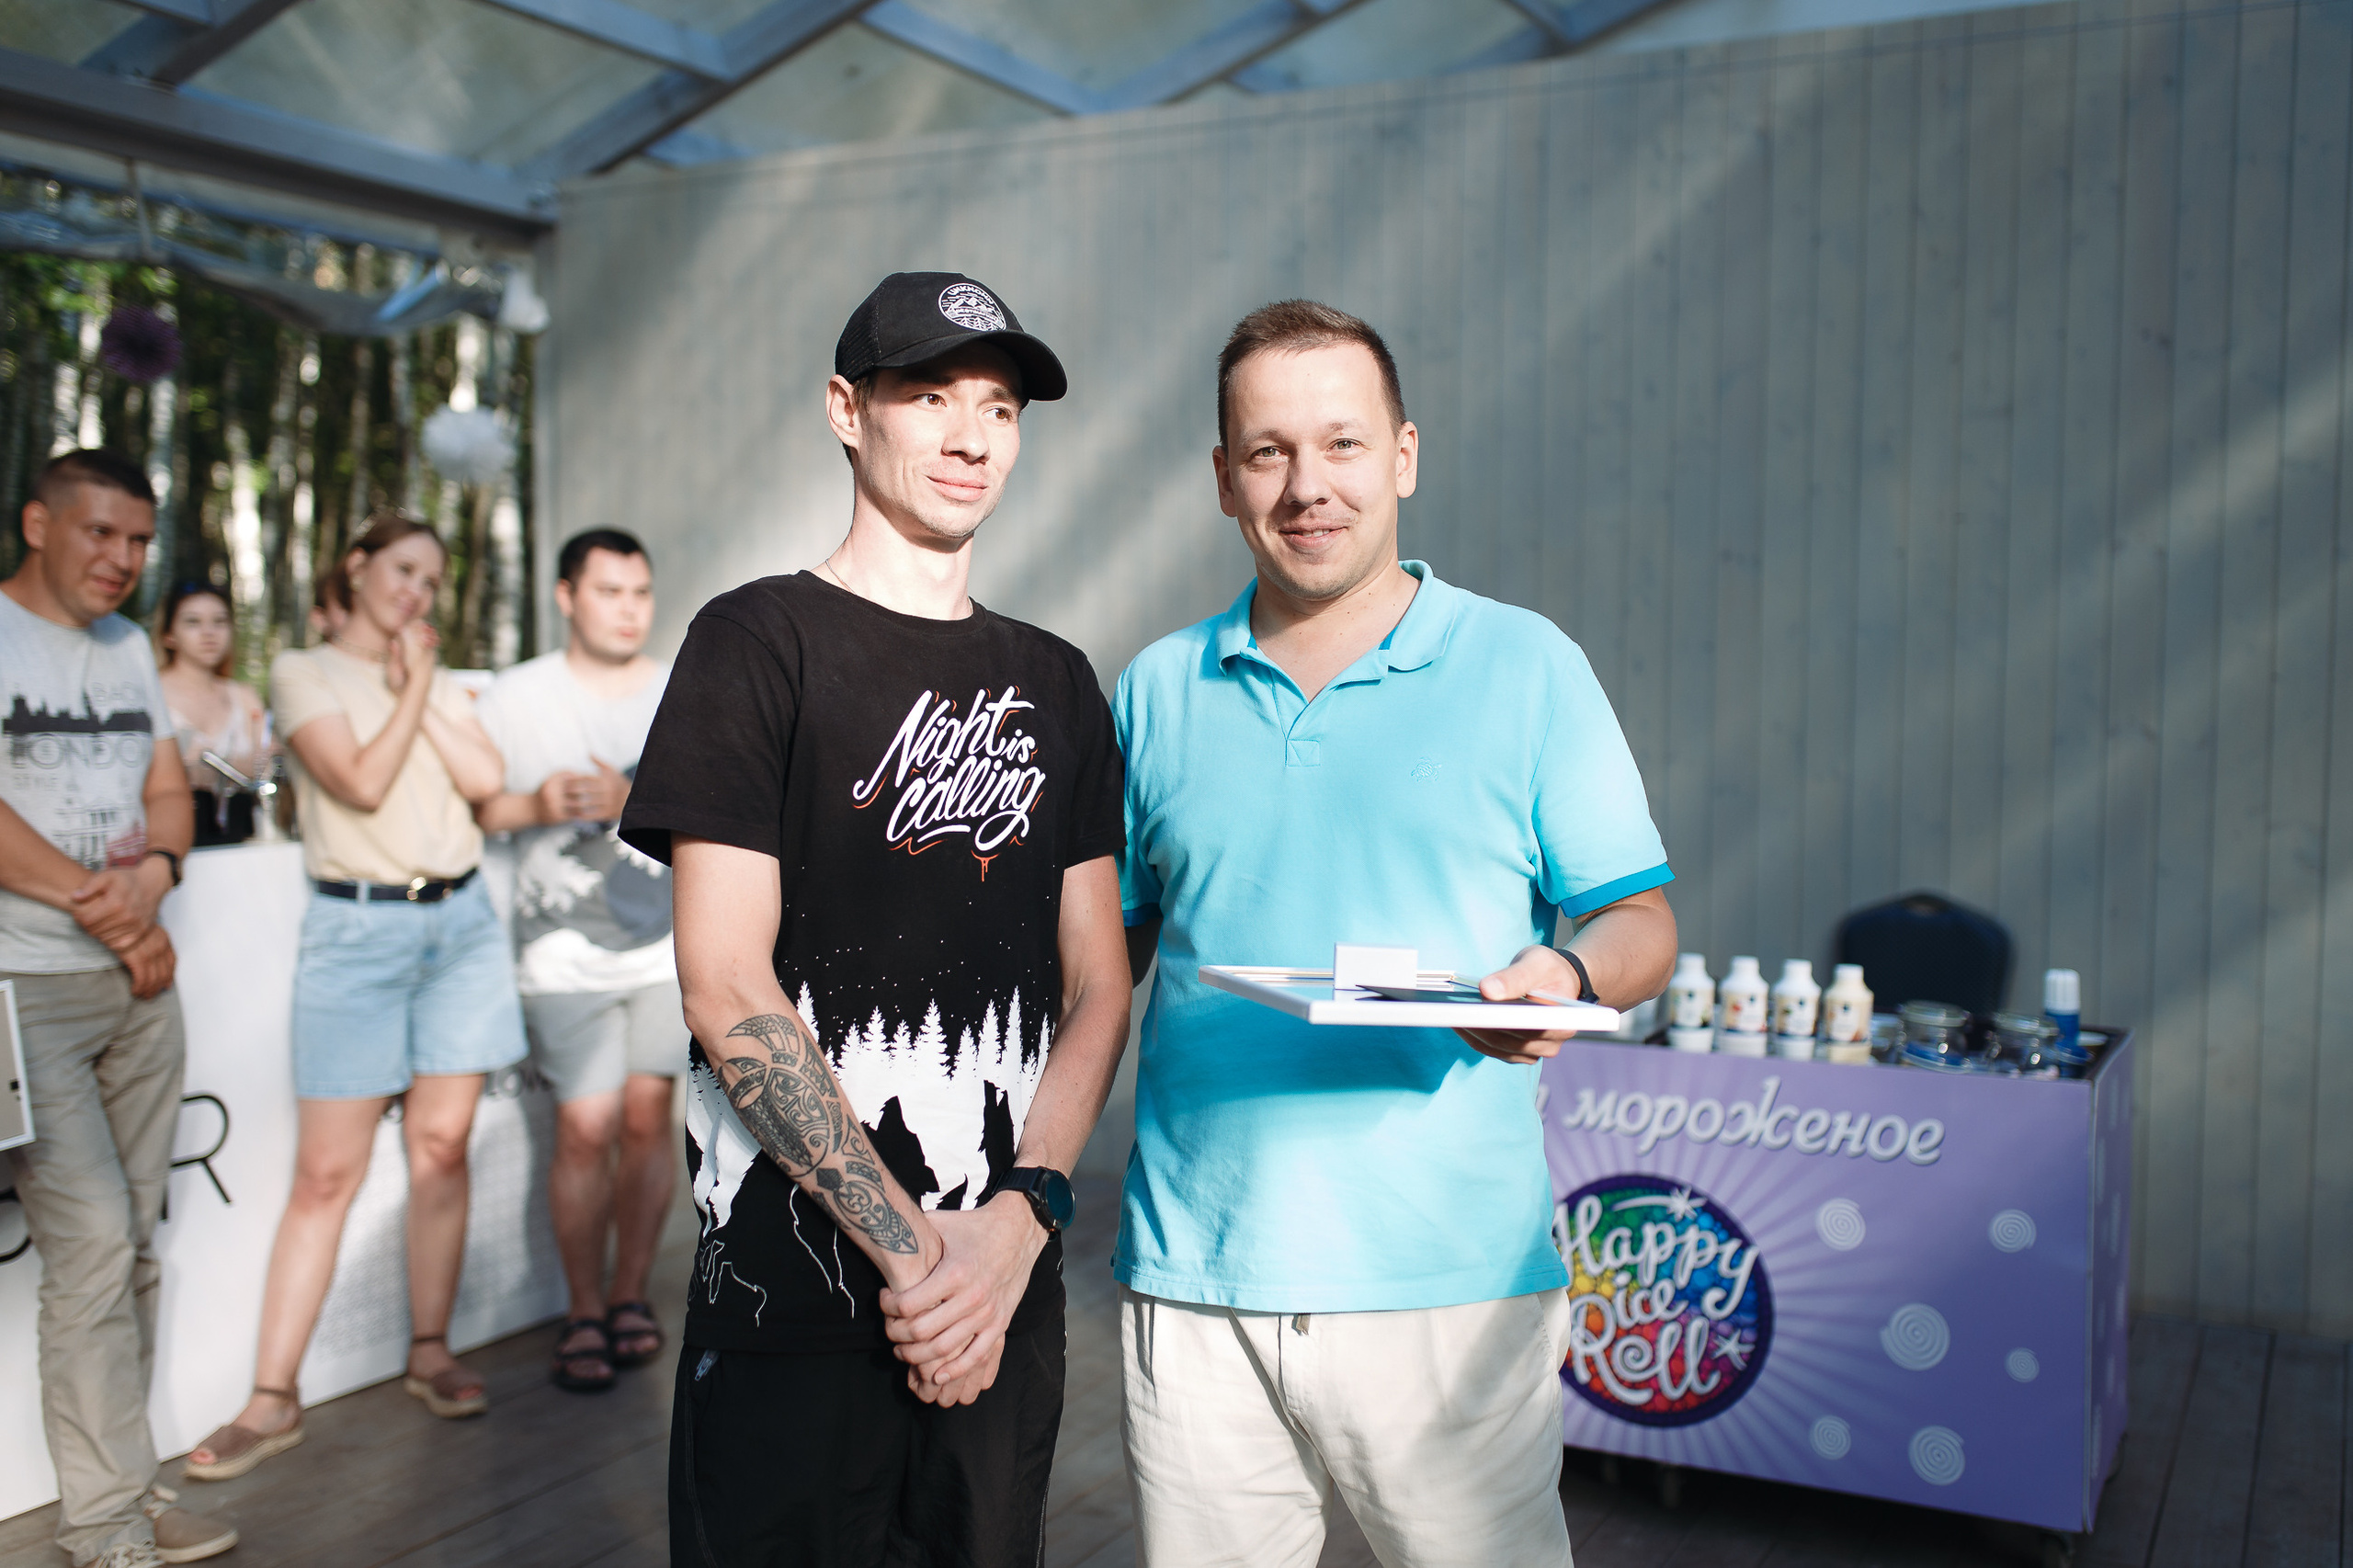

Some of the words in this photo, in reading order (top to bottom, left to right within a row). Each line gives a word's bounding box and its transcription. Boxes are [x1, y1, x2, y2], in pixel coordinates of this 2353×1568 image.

[852, 685, 1035, 801] Night
[1001, 729, 1036, 764] is
[1563, 1075, 1945, 1165] мороженое
[1552, 1195, 1760, 1320] Happy
[1568, 1293, 1722, 1405] Roll
